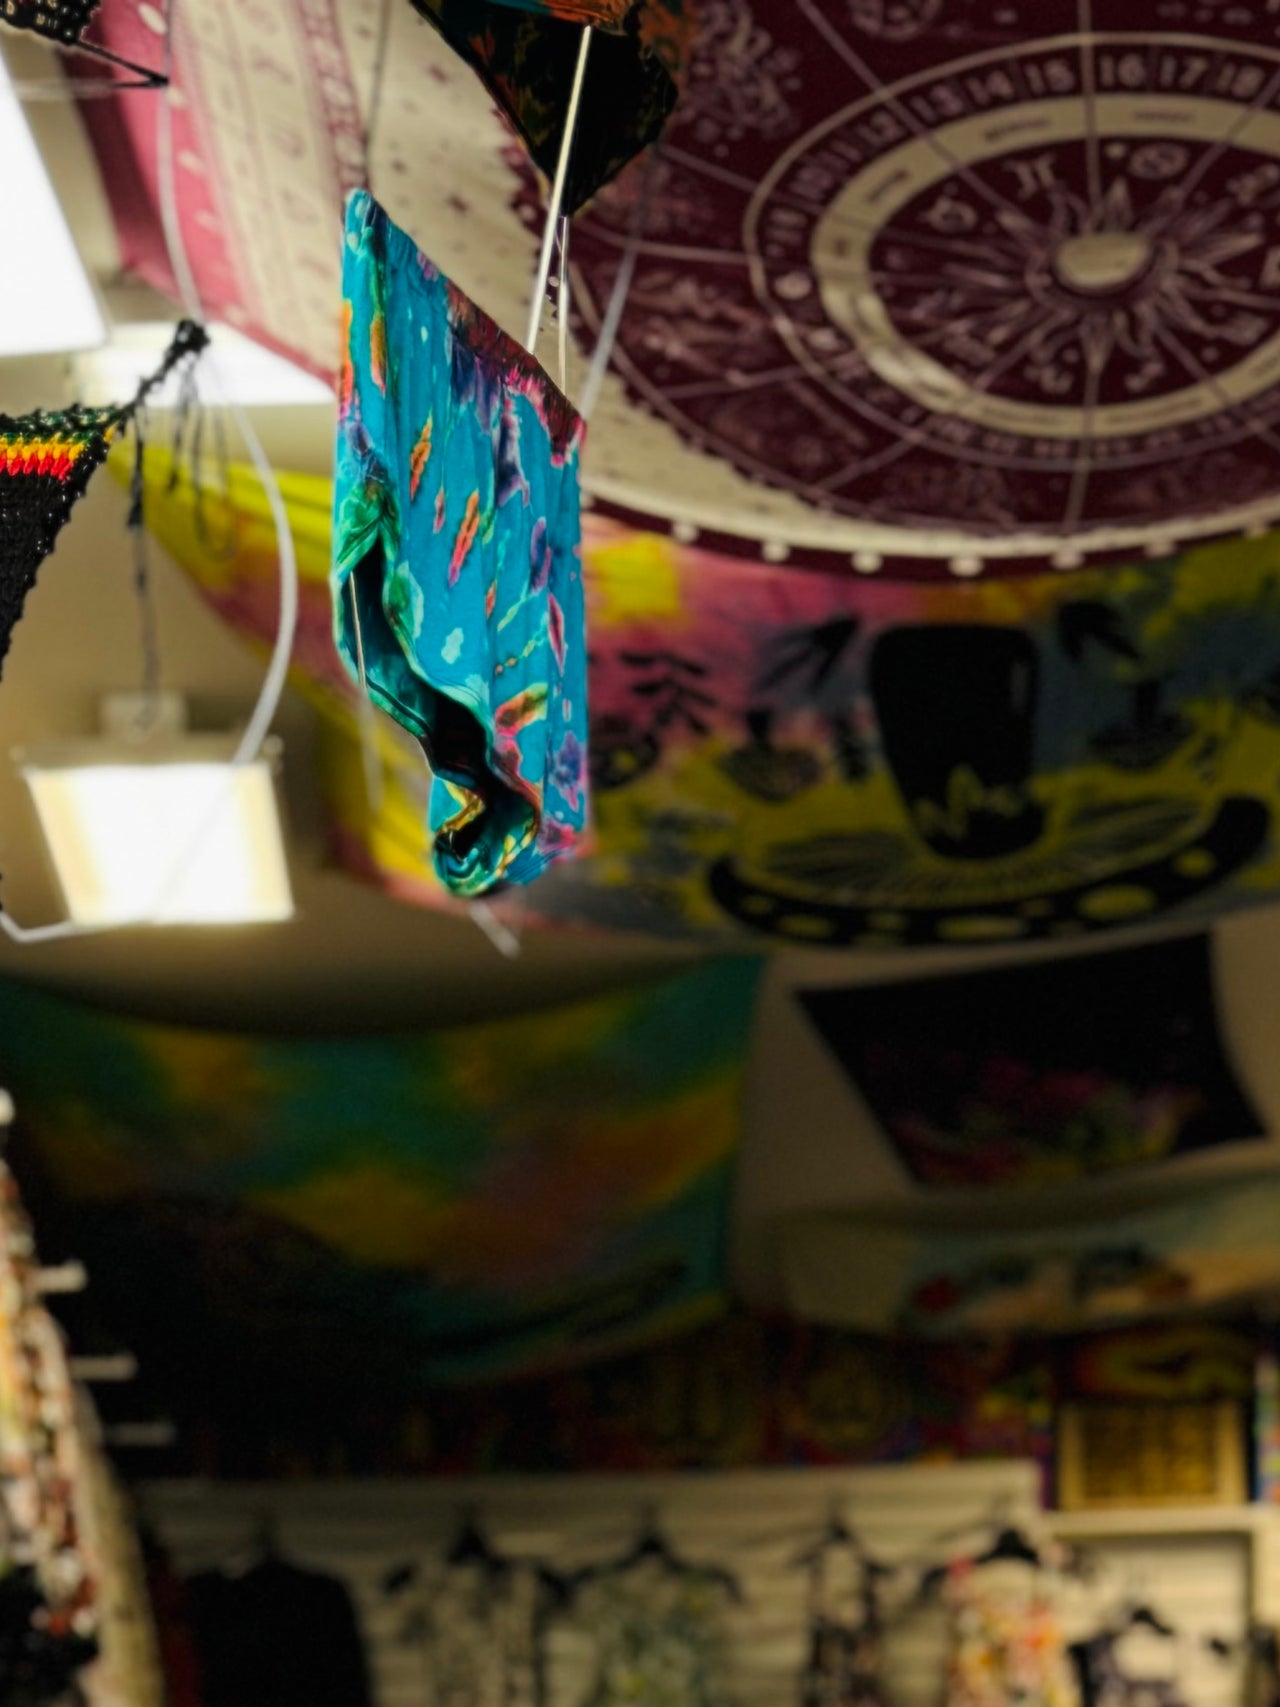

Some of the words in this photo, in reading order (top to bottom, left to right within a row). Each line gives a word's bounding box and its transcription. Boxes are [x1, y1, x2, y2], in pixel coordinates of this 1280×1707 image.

[909, 82, 966, 124] 13
[965, 69, 1016, 106] 14
[1022, 57, 1077, 94] 15
[1098, 53, 1147, 88] 16
[1157, 54, 1209, 89] 17
